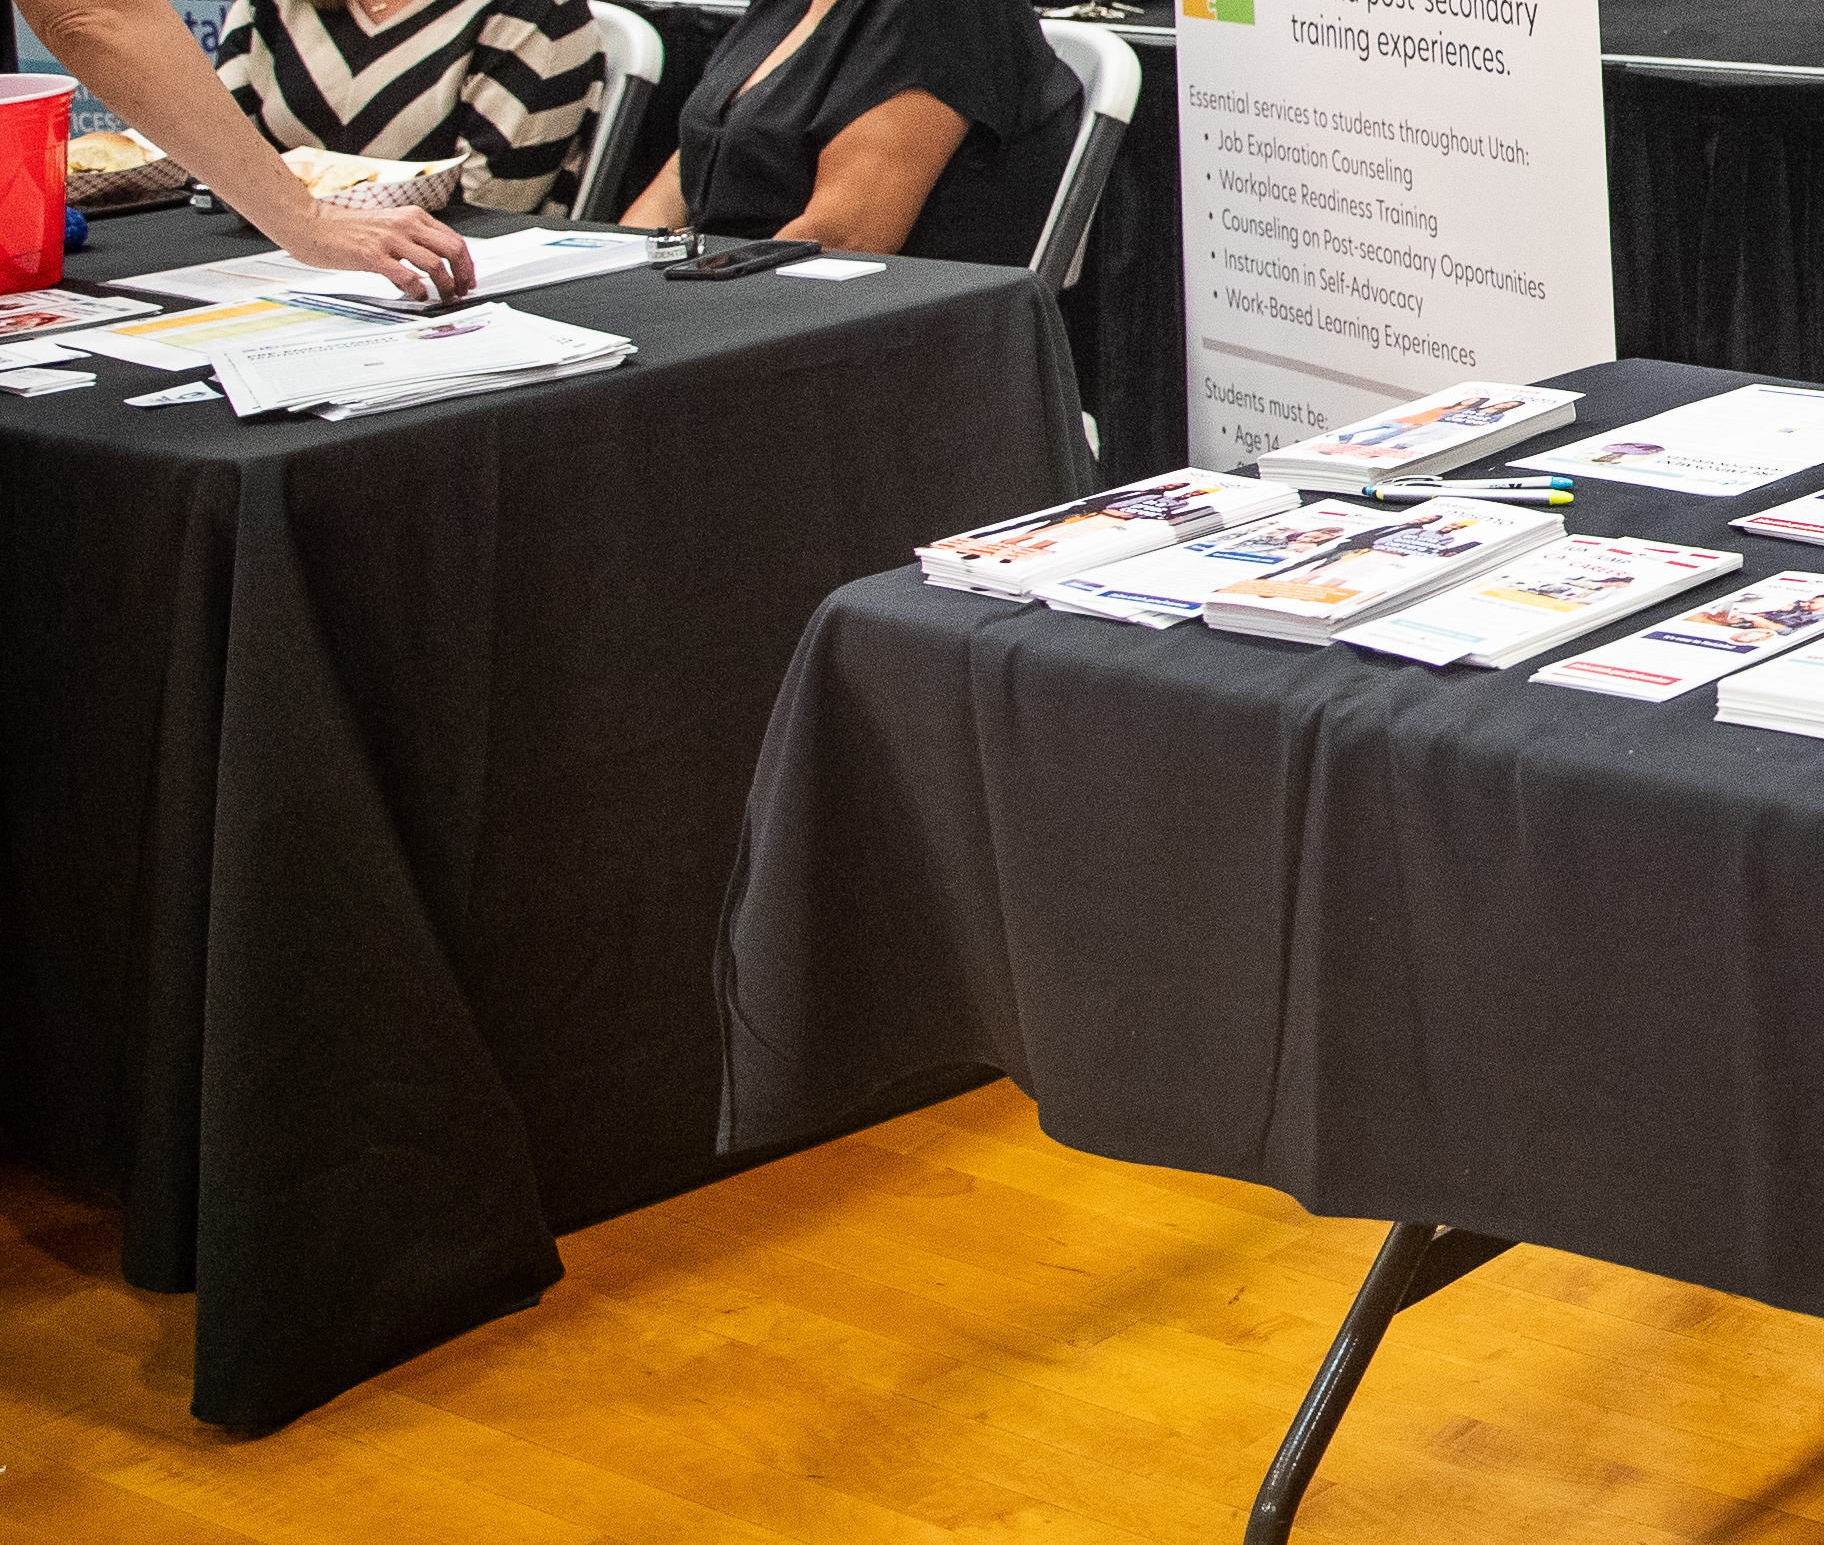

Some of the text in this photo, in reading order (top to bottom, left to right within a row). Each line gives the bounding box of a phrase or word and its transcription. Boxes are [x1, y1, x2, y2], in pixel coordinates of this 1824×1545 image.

[1291, 13, 1511, 77] training experiences.
[1189, 85, 1531, 166] Essential services to students throughout Utah:
[1217, 131, 1415, 191] Job Exploration Counseling
[1219, 169, 1439, 238] Workplace Readiness Training
[1221, 209, 1547, 301] Counseling on Post-secondary Opportunities
[1224, 248, 1424, 319] Instruction in Self-Advocacy
[1226, 287, 1477, 367] Work-Based Learning Experiences
[1205, 377, 1329, 432] Students must be:
[1235, 424, 1281, 454] Age 14
